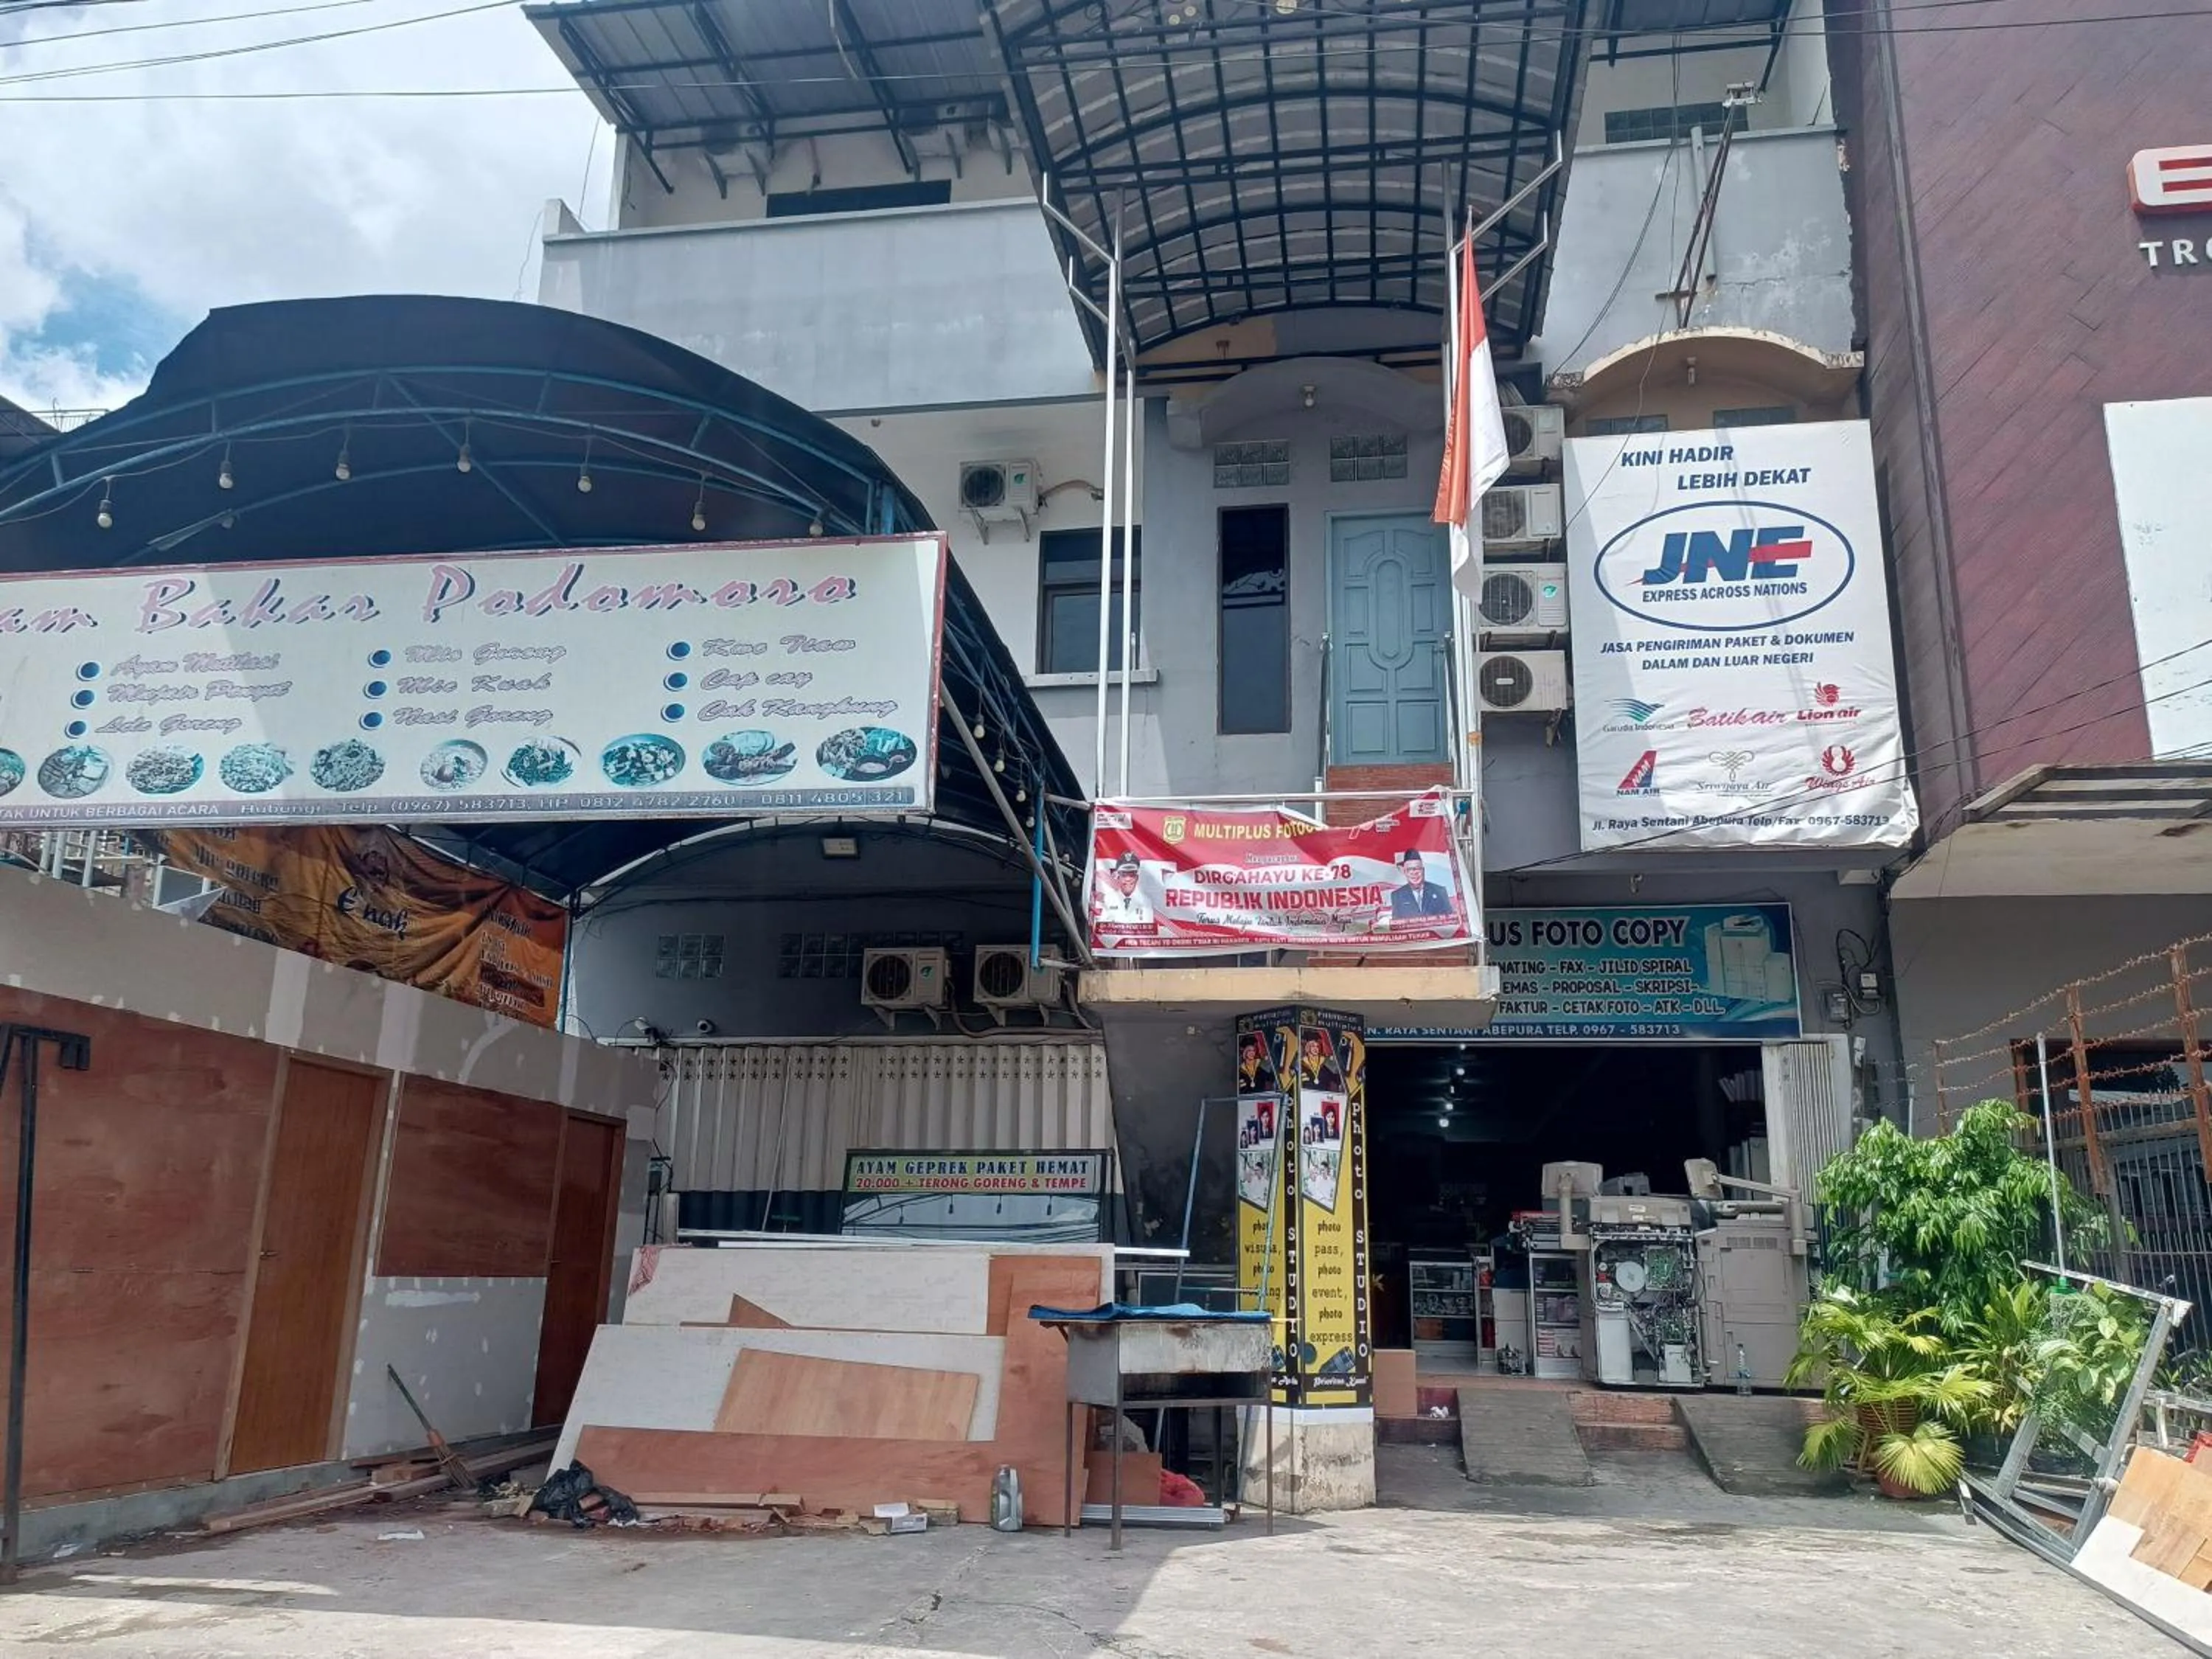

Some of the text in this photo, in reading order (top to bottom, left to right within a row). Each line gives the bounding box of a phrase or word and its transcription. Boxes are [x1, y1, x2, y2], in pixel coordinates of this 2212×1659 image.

[1621, 445, 1734, 467] KINI HADIR
[1677, 467, 1812, 490] LEBIH DEKAT
[1641, 526, 1812, 585] JNE
[135, 574, 381, 634] Bakar
[422, 563, 856, 624] Podomoro
[1642, 582, 1807, 602] EXPRESS ACROSS NATIONS
[1601, 631, 1854, 654] JASA PENGIRIMAN PAKET & DOKUMEN
[1643, 653, 1814, 671] DALAM DAN LUAR NEGERI
[700, 668, 759, 690] Cap
[1797, 706, 1861, 721] Lion air
[1603, 724, 1633, 732] Garuda
[1642, 788, 1660, 796] AIR
[29, 806, 80, 818] UNTUK
[86, 804, 162, 817] BERBAGAI
[167, 804, 219, 815] ACARA
[391, 800, 450, 812] (0967)
[539, 798, 568, 808] HP
[580, 797, 624, 808] 0812
[689, 795, 736, 806] 2760
[762, 793, 802, 804] 0811
[870, 790, 903, 801] 321
[1608, 818, 1638, 831] Raya
[1641, 815, 1688, 828] Sentani
[1808, 814, 1890, 827] 0967-583713
[1194, 824, 1270, 840] MULTIPLUS
[1194, 869, 1295, 885] DIRGAHAYU
[1166, 886, 1383, 911] REPUBLIK INDONESIA
[1197, 912, 1220, 925] Terus
[1489, 921, 1523, 947] US
[1532, 921, 1603, 946] FOTO
[1613, 919, 1686, 946] COPY
[1559, 961, 1584, 974] FAX
[1599, 960, 1638, 974] JILID
[1642, 959, 1692, 974] SPIRAL
[1552, 980, 1621, 994] PROPOSAL
[1499, 1001, 1548, 1015] FAKTUR
[1562, 1001, 1603, 1014] CETAK
[1607, 1000, 1639, 1014] FOTO
[1653, 1000, 1680, 1014] ATK
[1422, 1026, 1478, 1036] SENTANI
[1483, 1024, 1543, 1035] ABEPURA
[1548, 1024, 1579, 1035] TELP.
[1583, 1023, 1614, 1035] 0967
[1630, 1023, 1680, 1035] 583713
[856, 1160, 1088, 1175] AYAM GEPREK PAKET HEMAT
[856, 1178, 900, 1189] 20.000
[918, 1177, 969, 1189] TERONG
[973, 1177, 1026, 1189] GORENG
[1032, 1177, 1040, 1188] &
[1044, 1177, 1087, 1189] TEMPE
[1318, 1220, 1341, 1235] photo
[1315, 1243, 1344, 1258] pass,
[1318, 1264, 1342, 1279] photo
[1312, 1286, 1348, 1300] event,
[1356, 1230, 1368, 1357] STUDIO
[1318, 1307, 1343, 1322] photo
[1309, 1331, 1353, 1344] express
